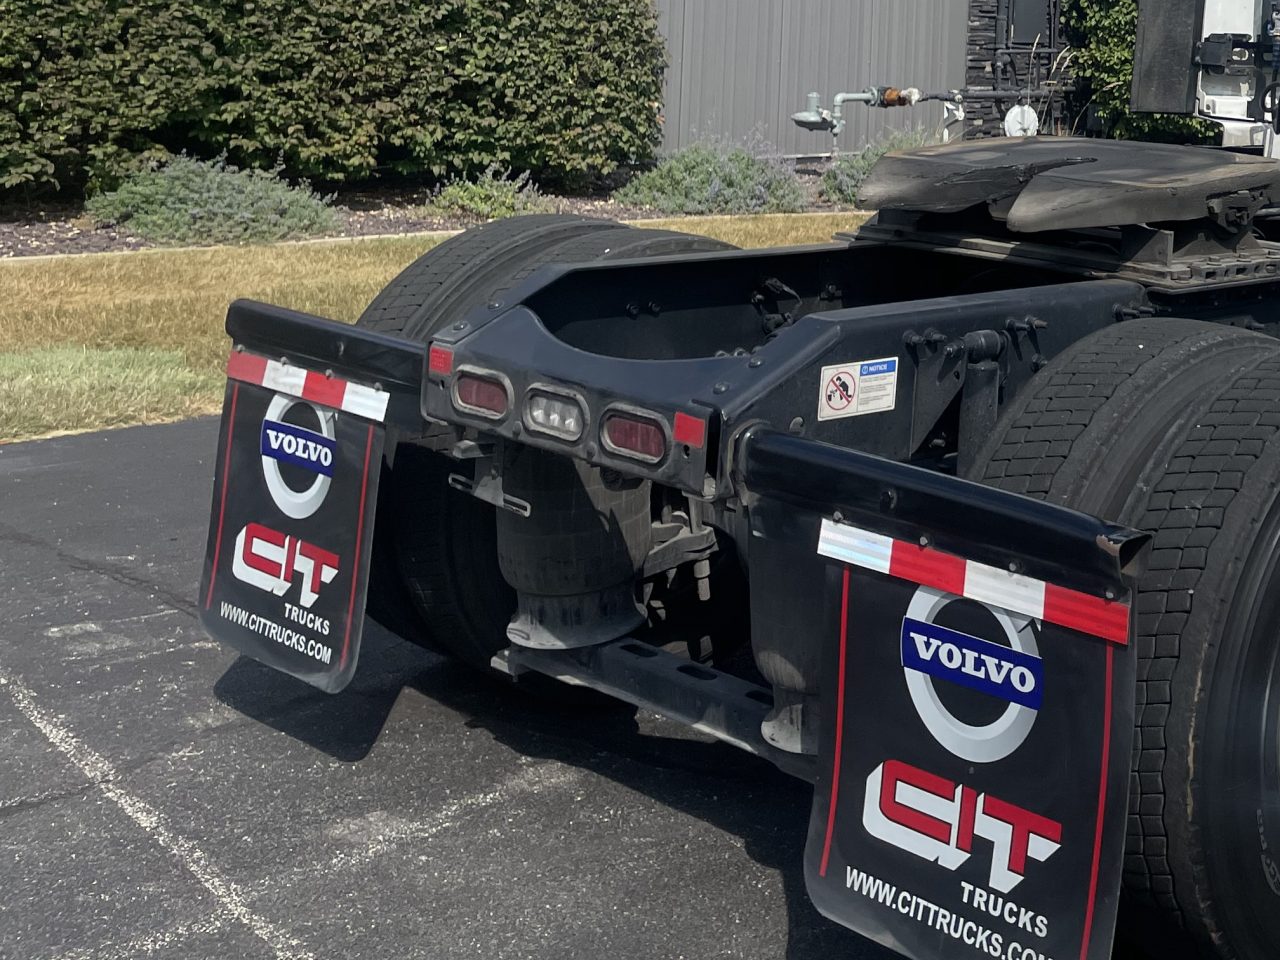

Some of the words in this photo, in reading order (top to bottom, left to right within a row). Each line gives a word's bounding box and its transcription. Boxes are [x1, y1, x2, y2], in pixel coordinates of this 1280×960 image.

[266, 429, 333, 468] VOLVO
[232, 522, 340, 608] CIT
[220, 601, 332, 665] WWW.CITTRUCKS.COM
[284, 603, 330, 636] TRUCKS
[909, 631, 1036, 693] VOLVO
[862, 759, 1063, 894] CIT
[960, 881, 1048, 938] TRUCKS
